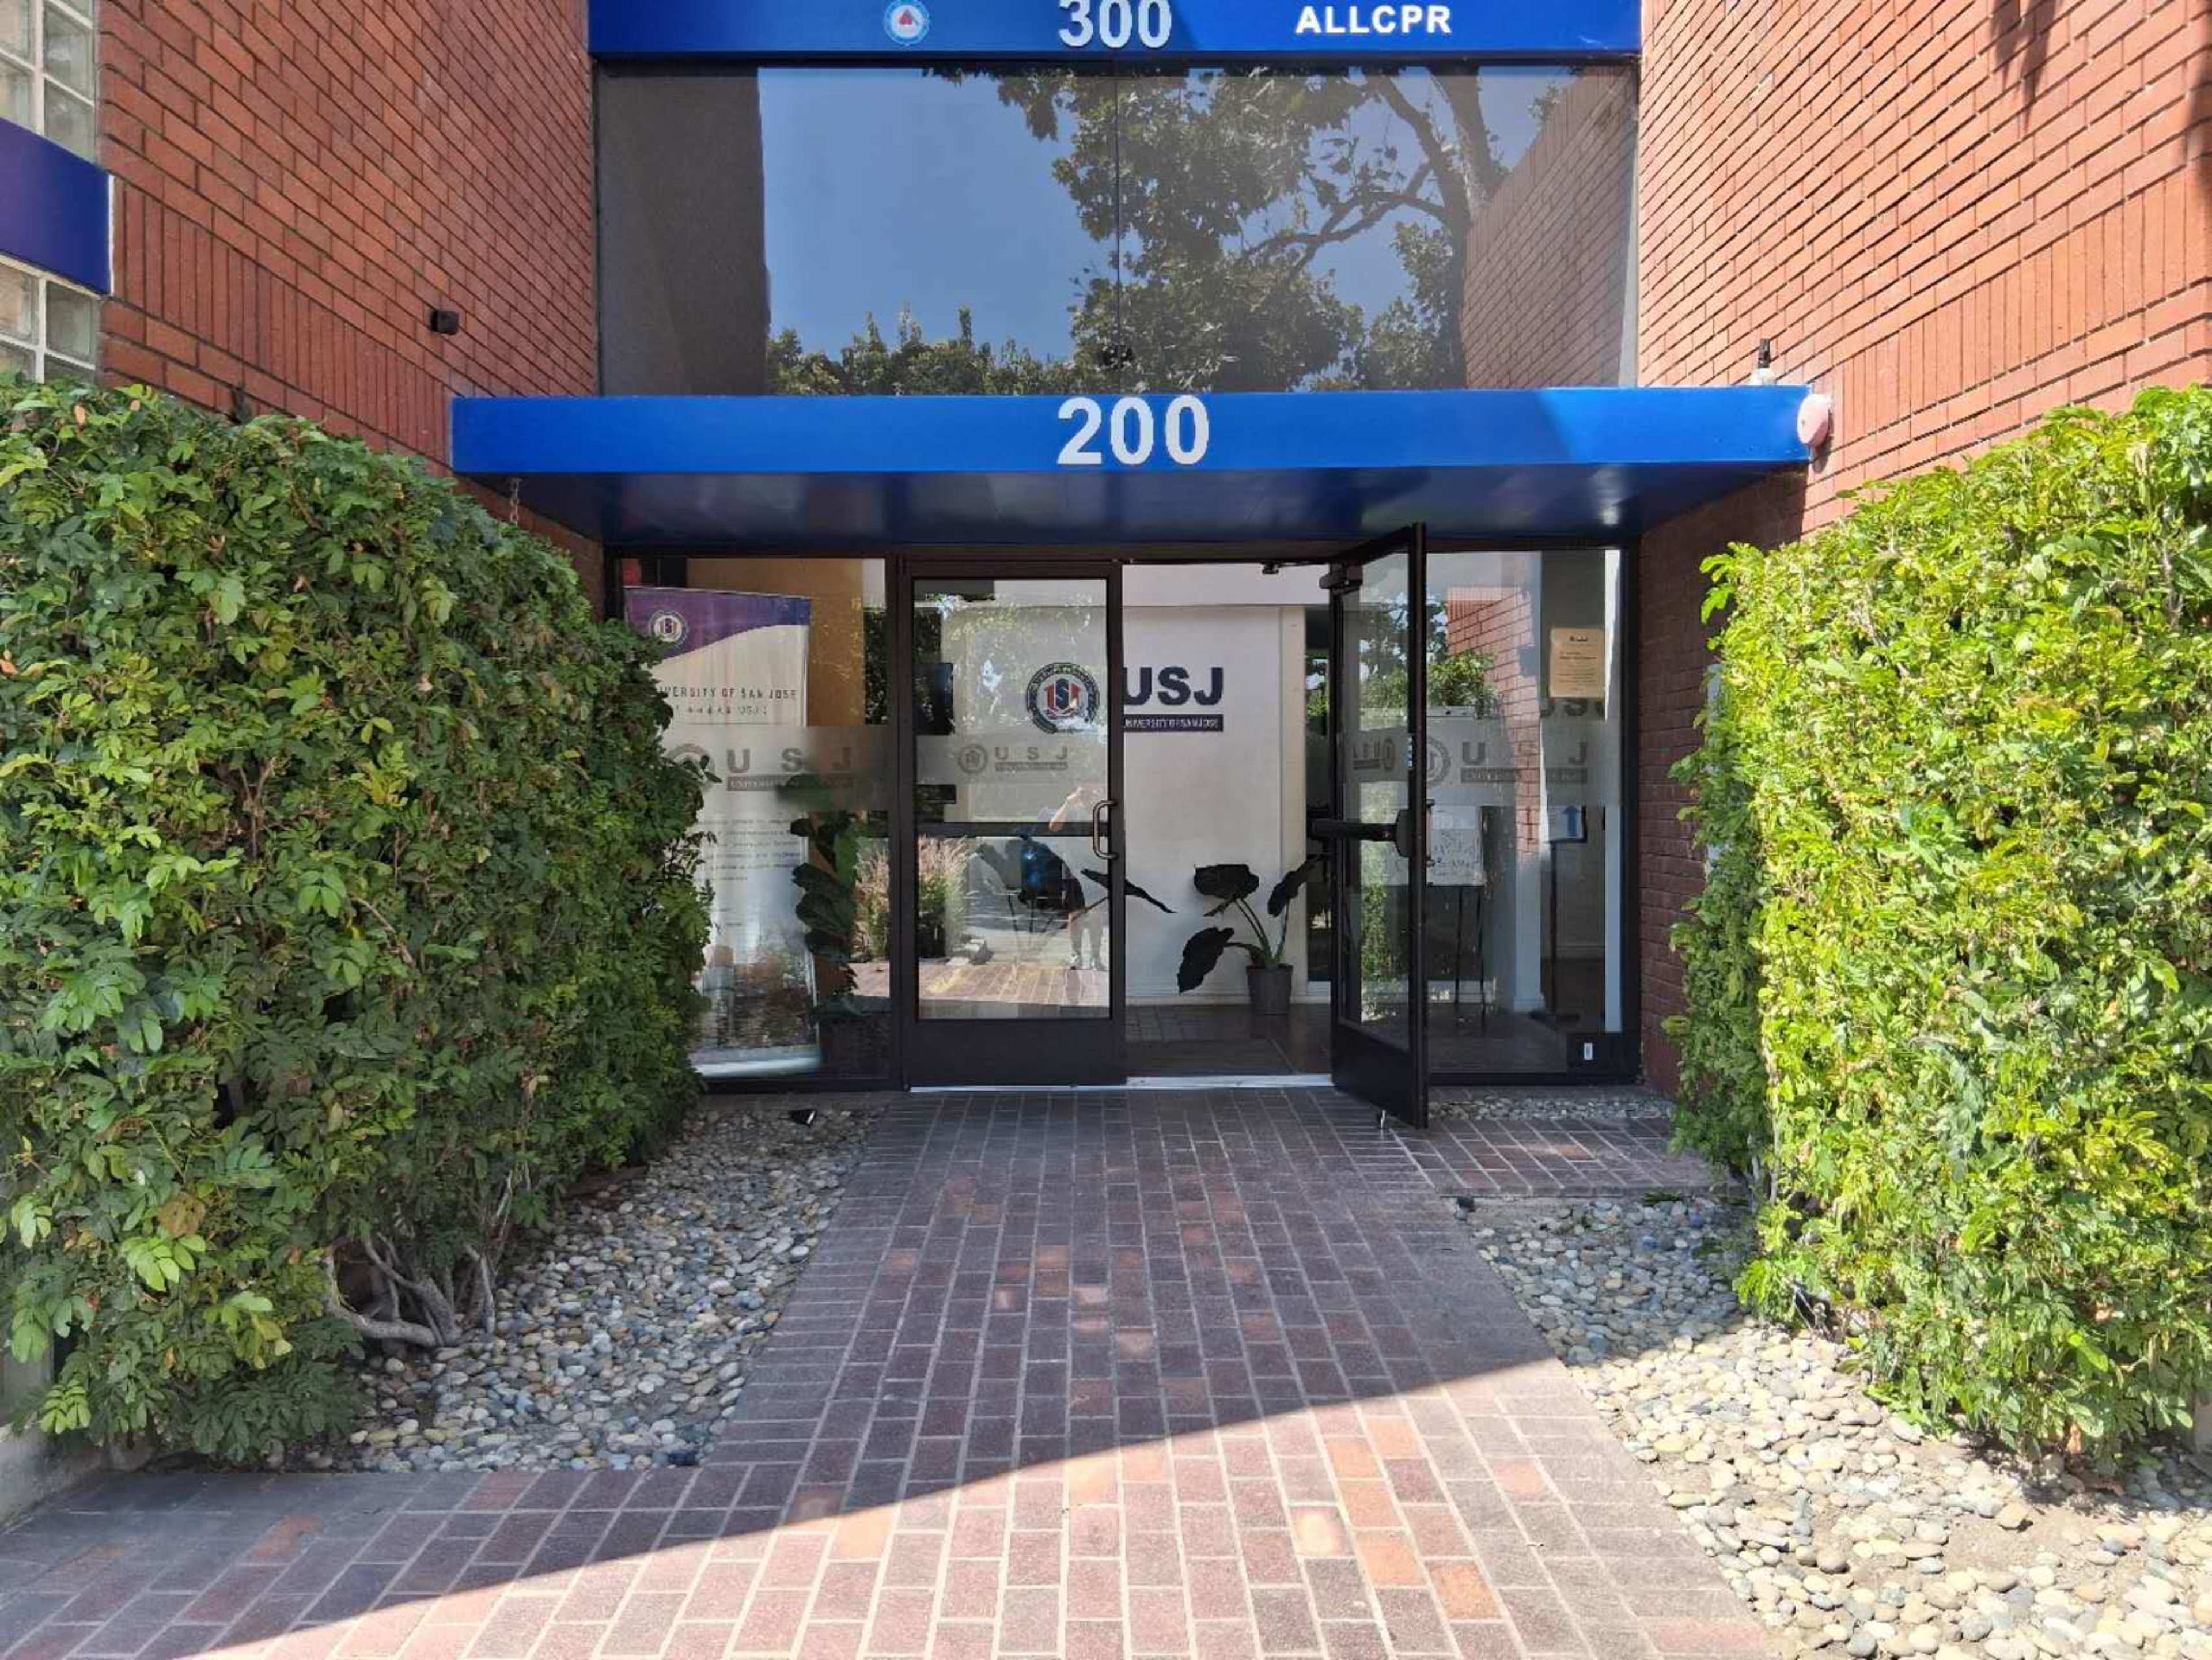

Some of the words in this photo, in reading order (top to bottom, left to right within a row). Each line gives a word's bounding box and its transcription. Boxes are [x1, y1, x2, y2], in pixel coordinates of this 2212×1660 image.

[1058, 0, 1172, 47] 300
[1296, 5, 1452, 34] ALLCPR
[1057, 395, 1209, 465] 200
[1123, 667, 1224, 706] USJ
